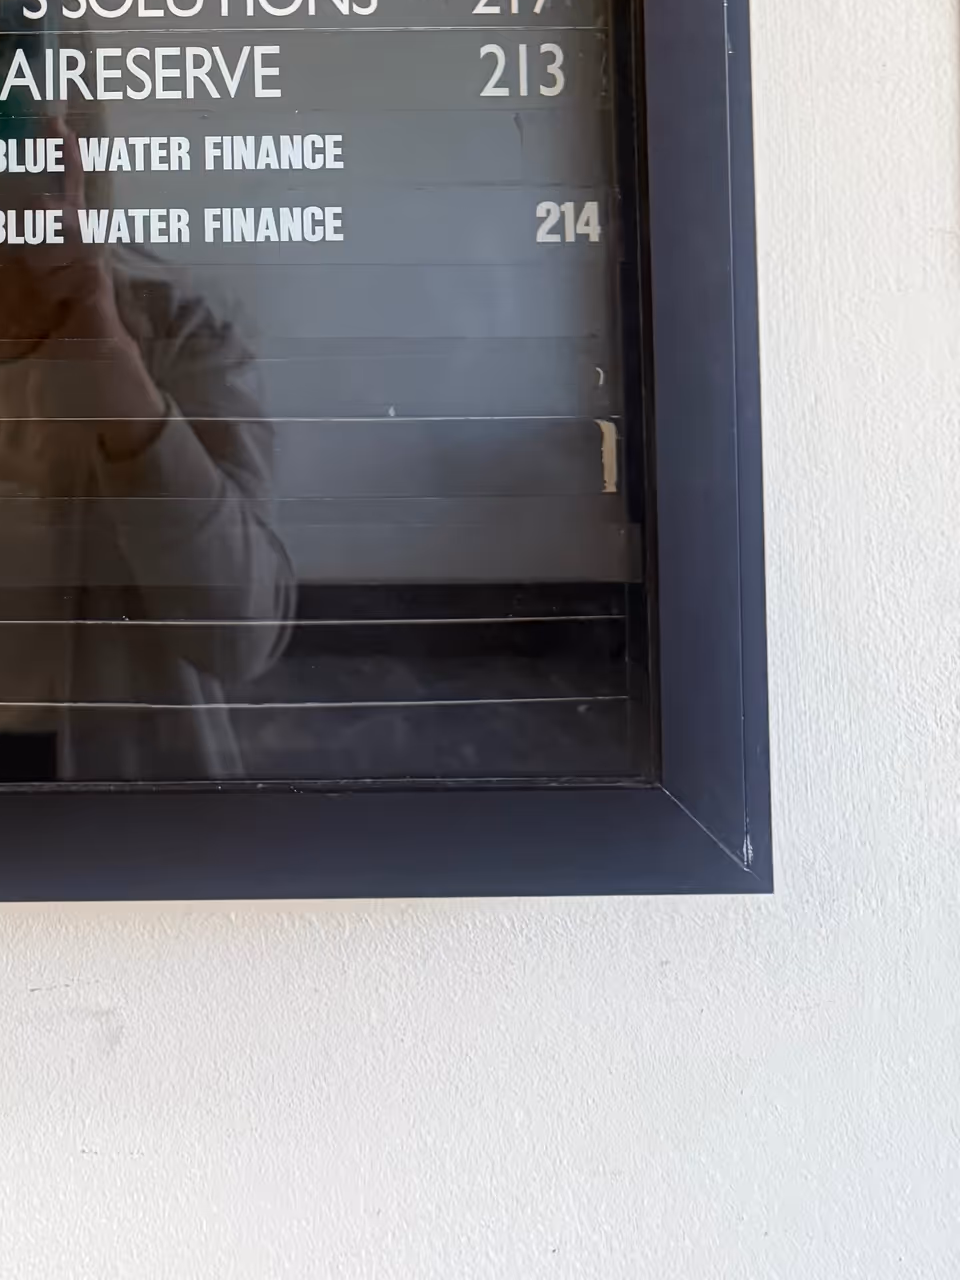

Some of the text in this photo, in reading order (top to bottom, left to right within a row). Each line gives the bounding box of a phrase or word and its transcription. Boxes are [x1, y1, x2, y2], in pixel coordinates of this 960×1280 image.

[0, 43, 565, 101] AIRESERVE 213
[79, 135, 191, 172] WATER
[205, 134, 343, 170] FINANCE
[78, 208, 190, 244] WATER
[205, 206, 343, 243] FINANCE
[536, 201, 601, 243] 214
